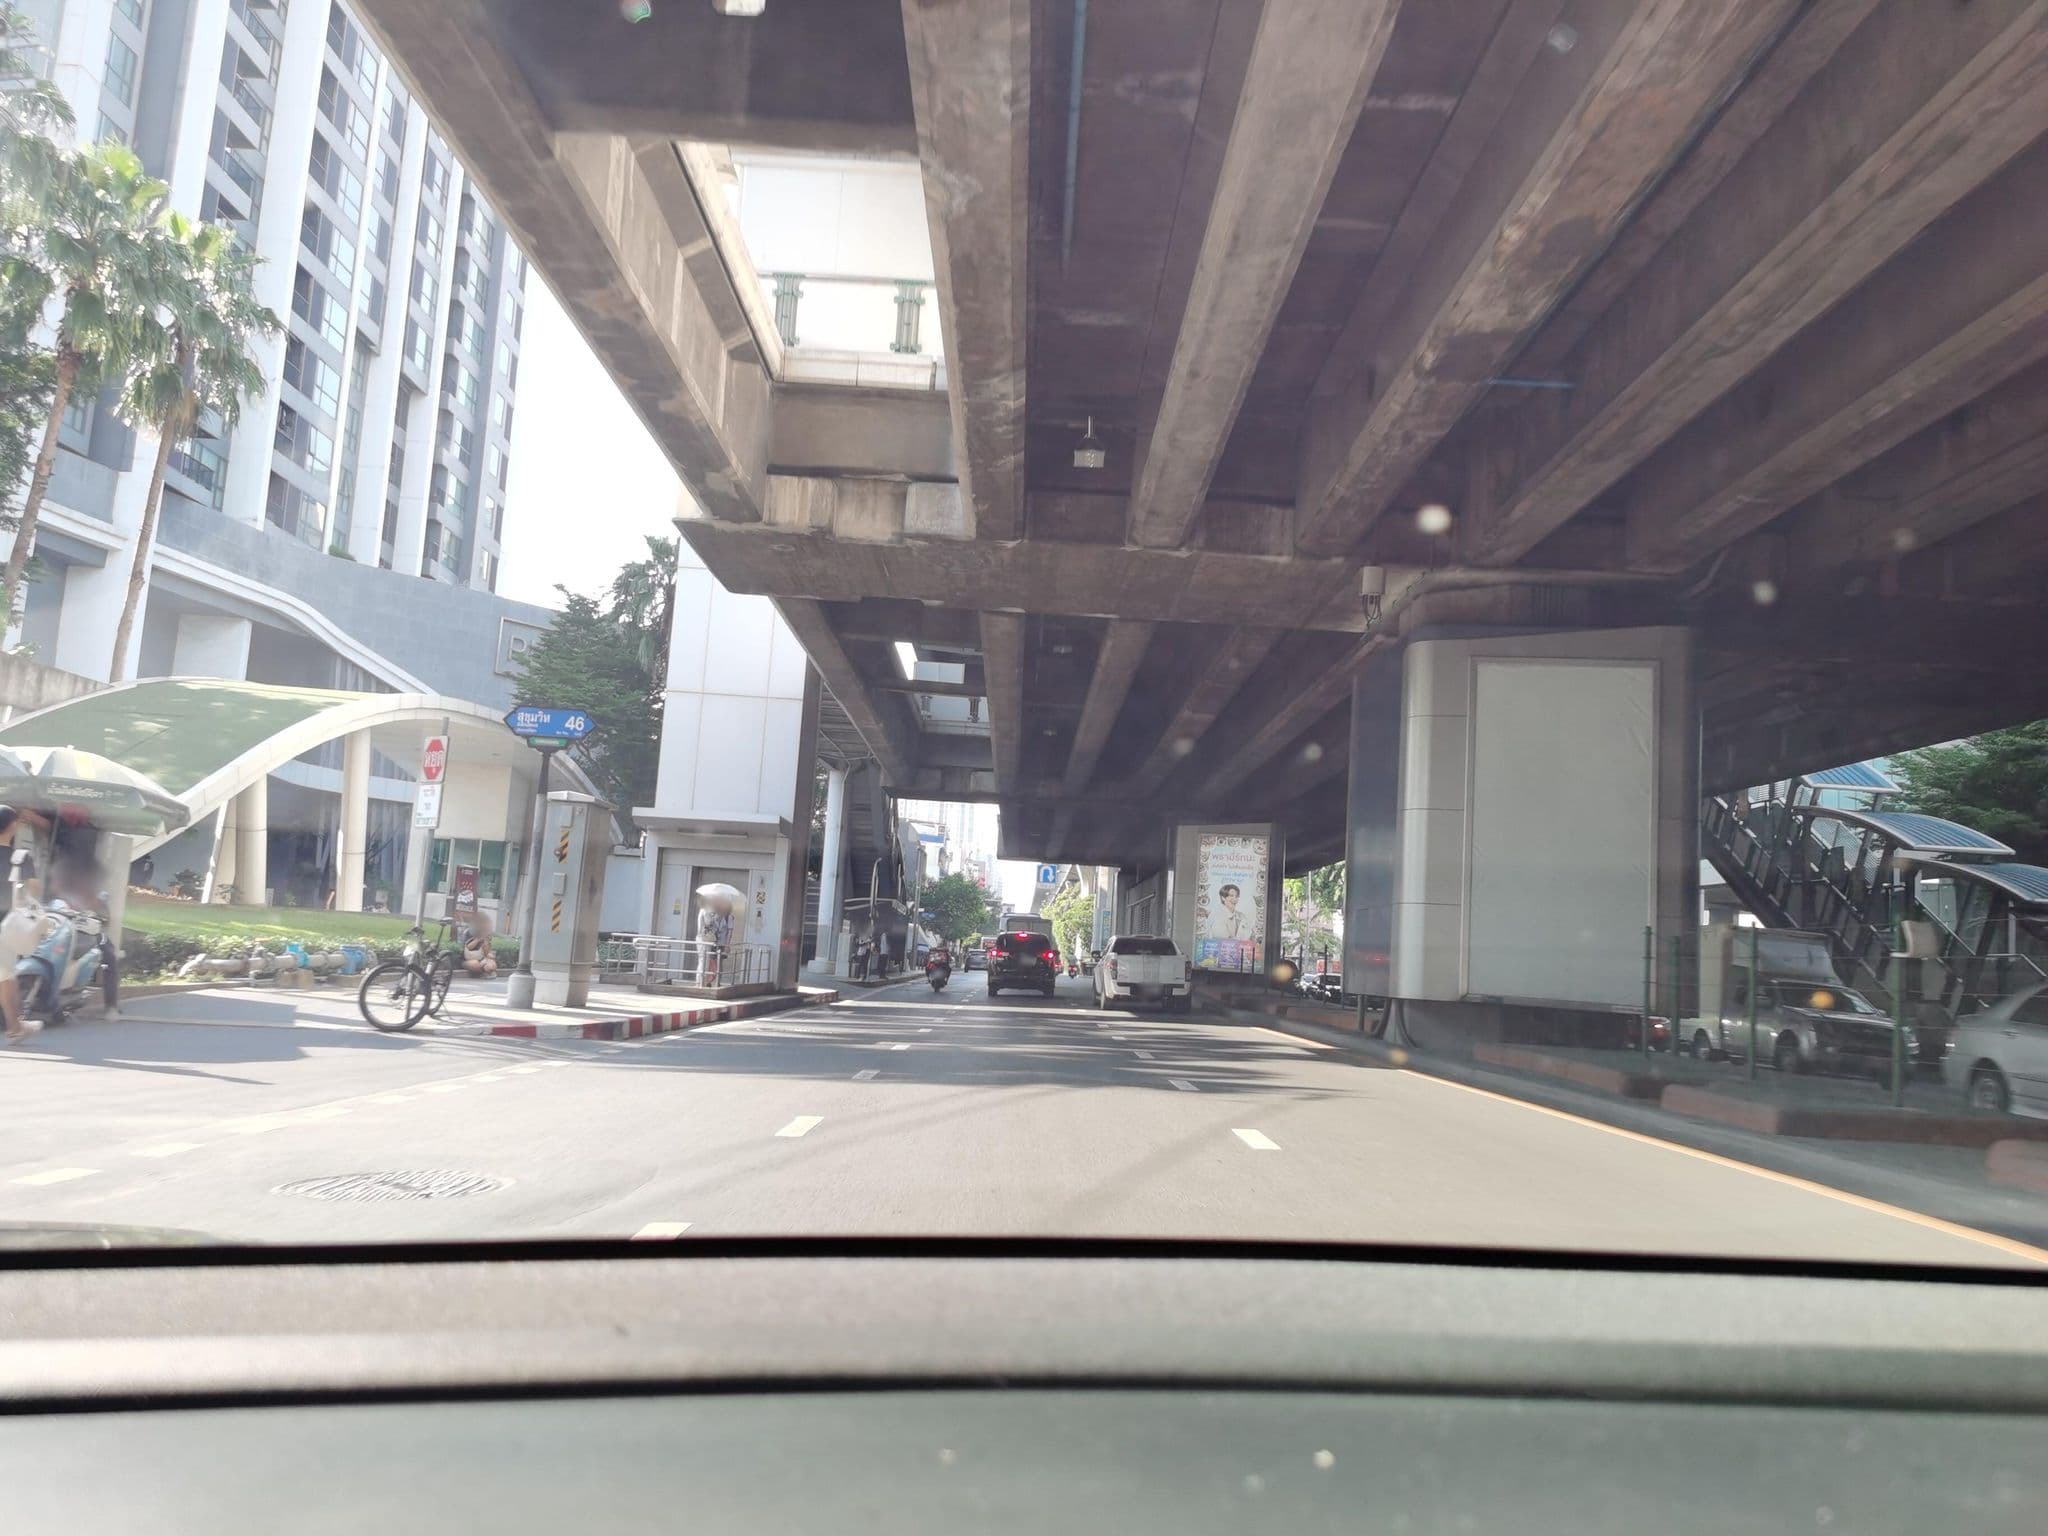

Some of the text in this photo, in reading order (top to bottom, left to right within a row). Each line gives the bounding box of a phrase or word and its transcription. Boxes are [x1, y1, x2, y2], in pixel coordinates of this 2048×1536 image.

[517, 711, 585, 731] สุขุมวิท 46
[422, 750, 445, 774] หยุด
